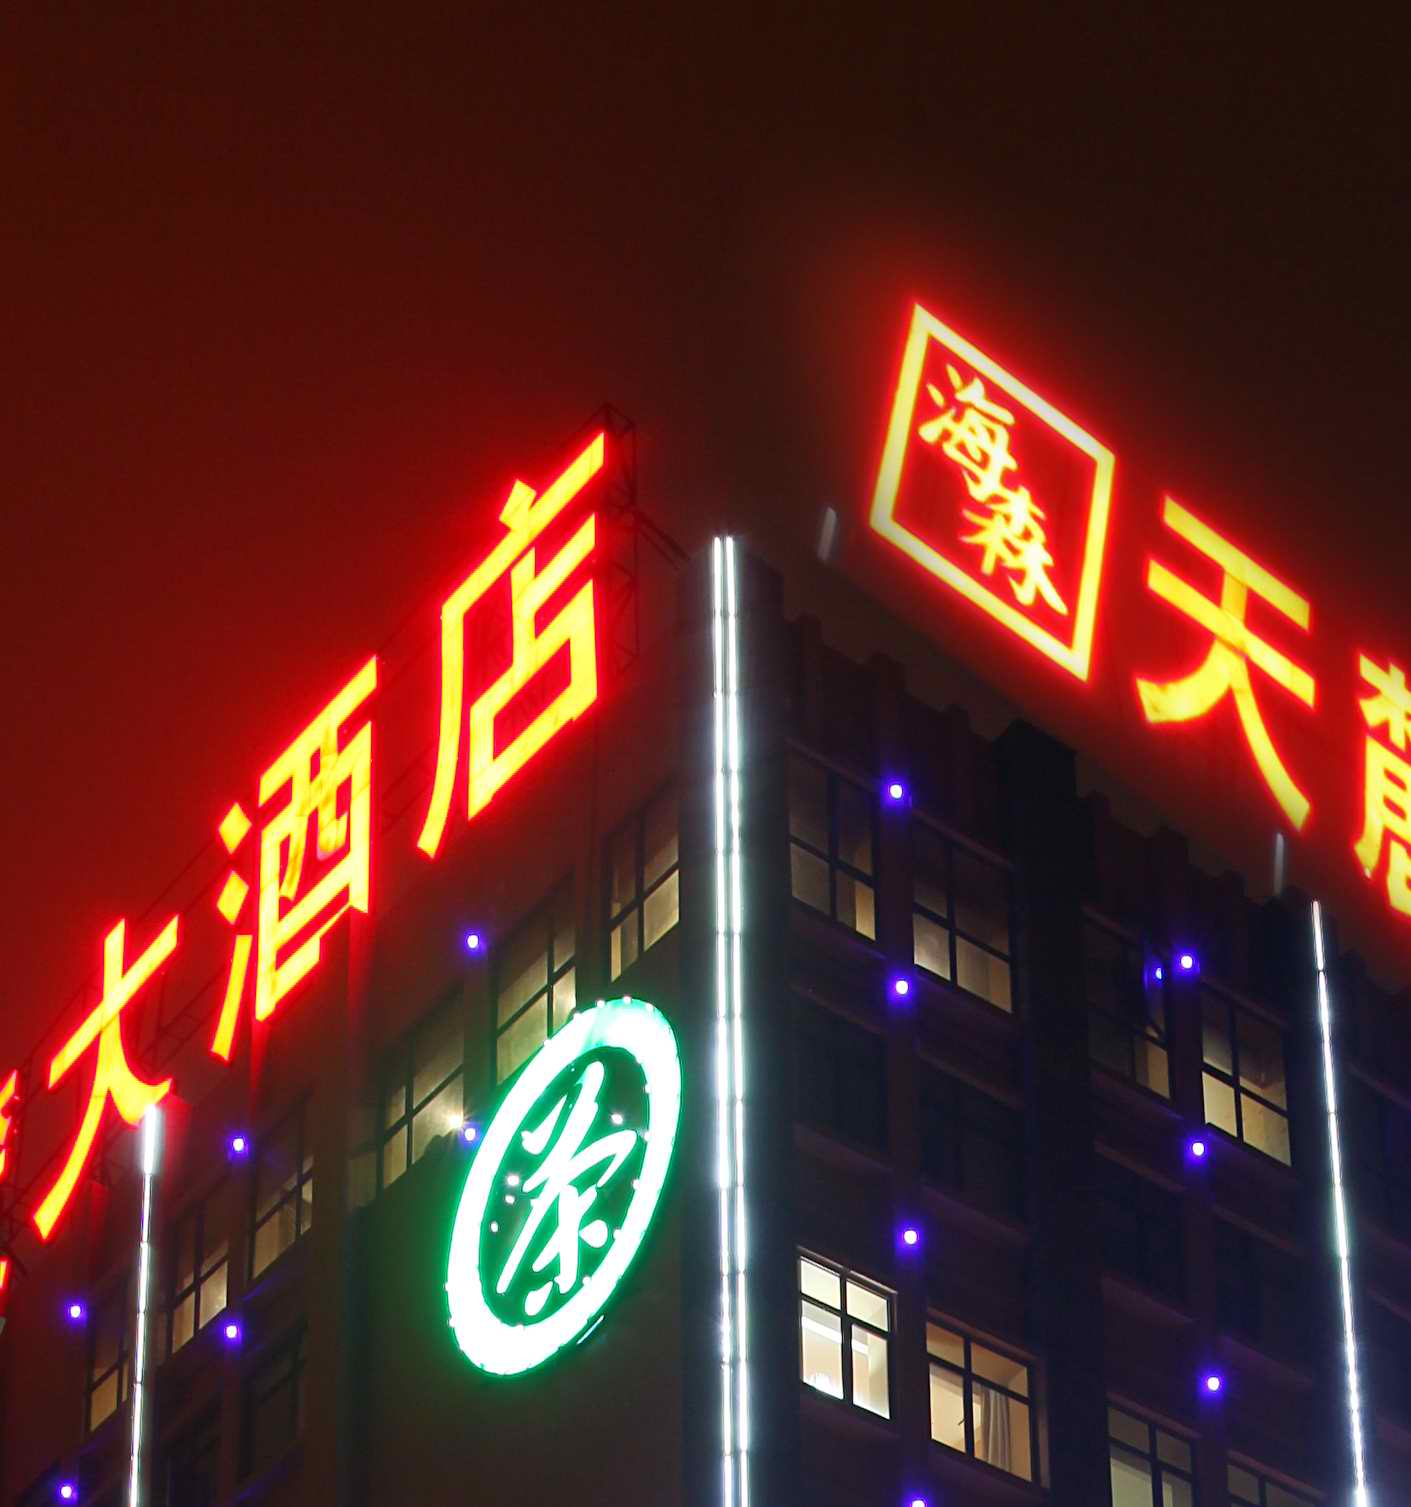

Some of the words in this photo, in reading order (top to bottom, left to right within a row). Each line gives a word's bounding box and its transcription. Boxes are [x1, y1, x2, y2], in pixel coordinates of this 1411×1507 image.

[918, 362, 1069, 617] 海森
[0, 430, 608, 1290] 大酒店
